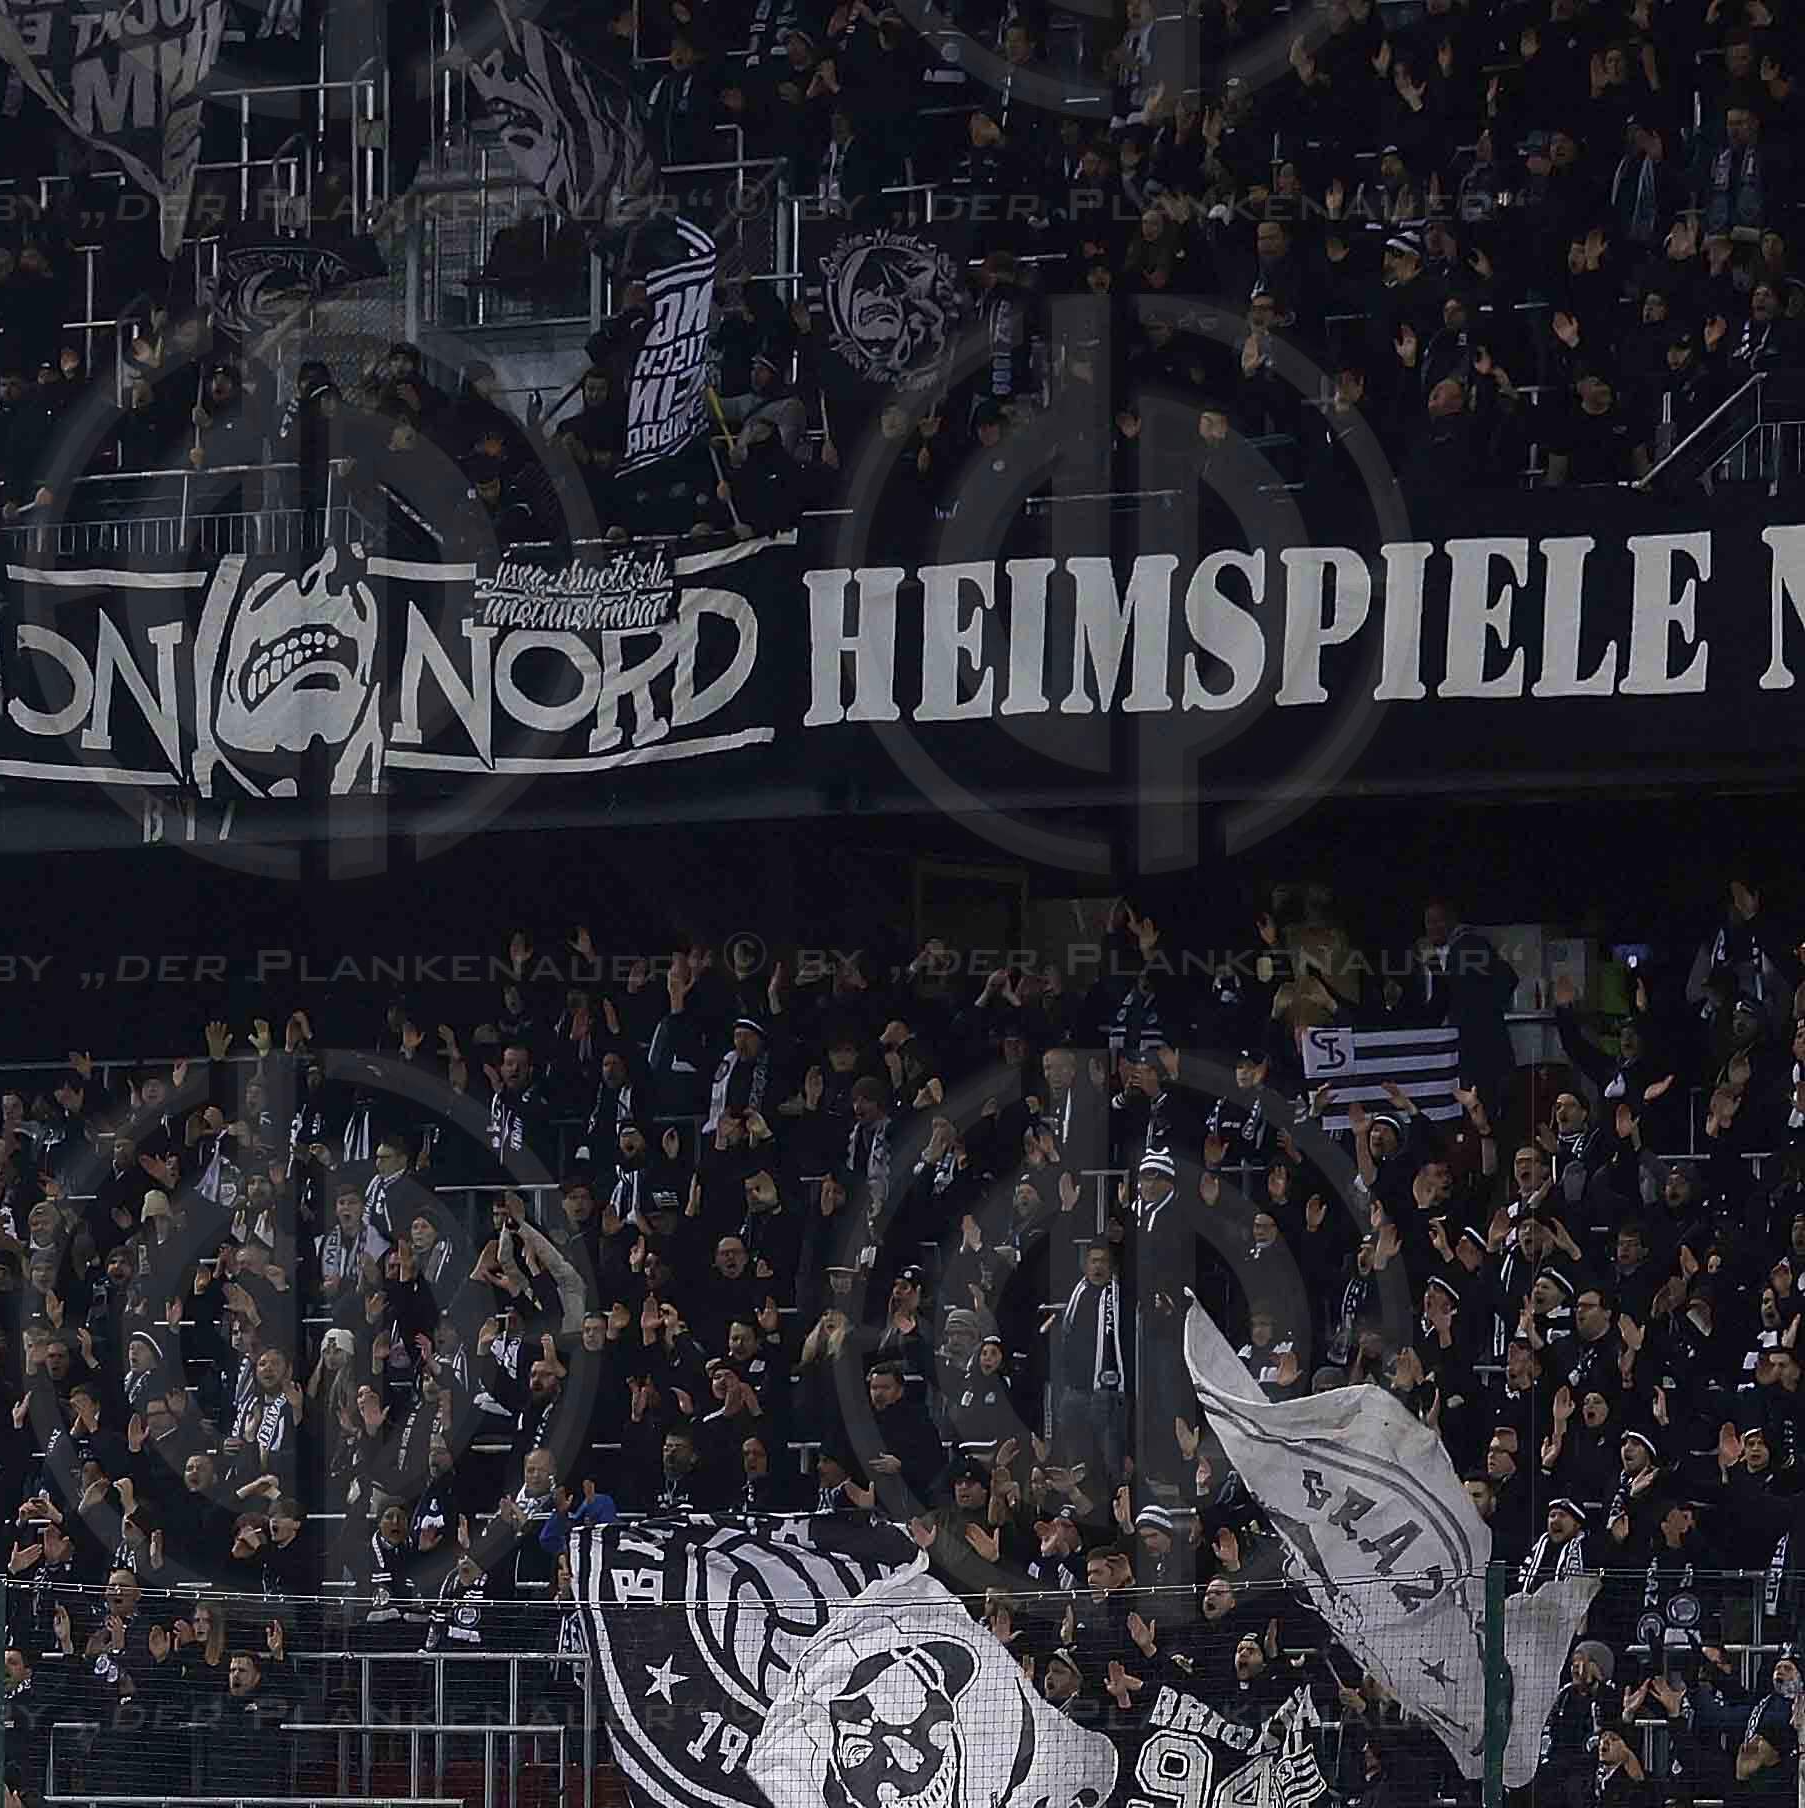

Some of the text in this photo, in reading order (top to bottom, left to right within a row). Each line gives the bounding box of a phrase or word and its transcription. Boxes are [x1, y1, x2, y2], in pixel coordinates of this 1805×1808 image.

[395, 589, 761, 771] NORD
[800, 531, 1713, 728] HEIMSPIELE
[1301, 1468, 1445, 1614] GRAZ
